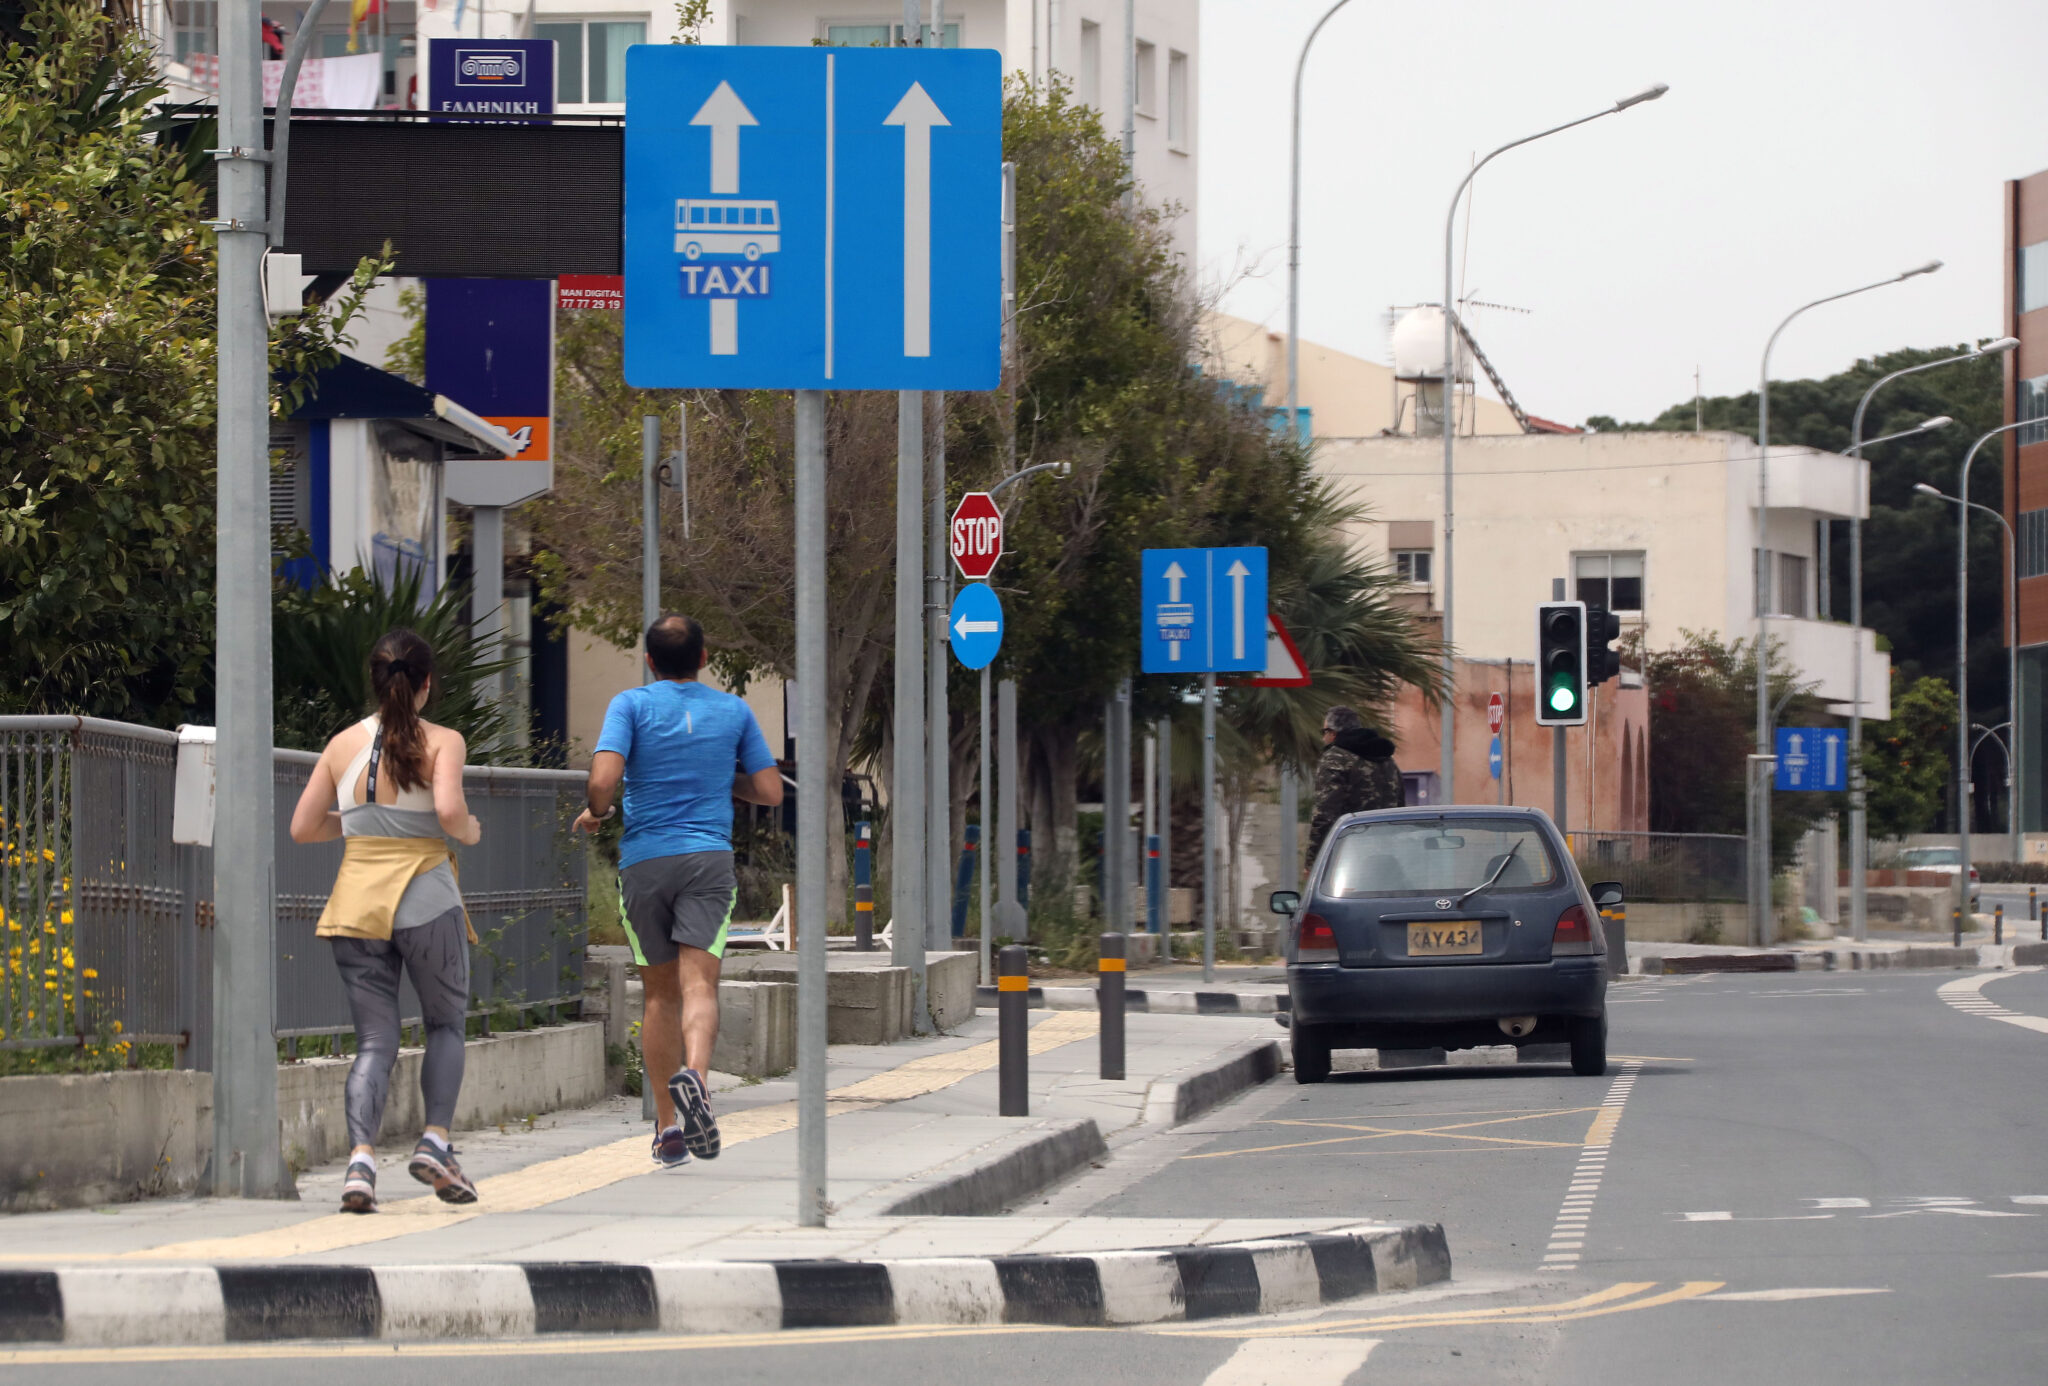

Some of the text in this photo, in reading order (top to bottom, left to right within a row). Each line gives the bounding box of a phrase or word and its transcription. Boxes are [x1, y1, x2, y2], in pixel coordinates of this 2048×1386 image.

[680, 266, 769, 294] TAXI
[560, 289, 624, 298] MAN DIGITAL
[561, 299, 620, 309] 77 77 29 19
[953, 517, 999, 557] STOP
[1489, 705, 1503, 724] STOP
